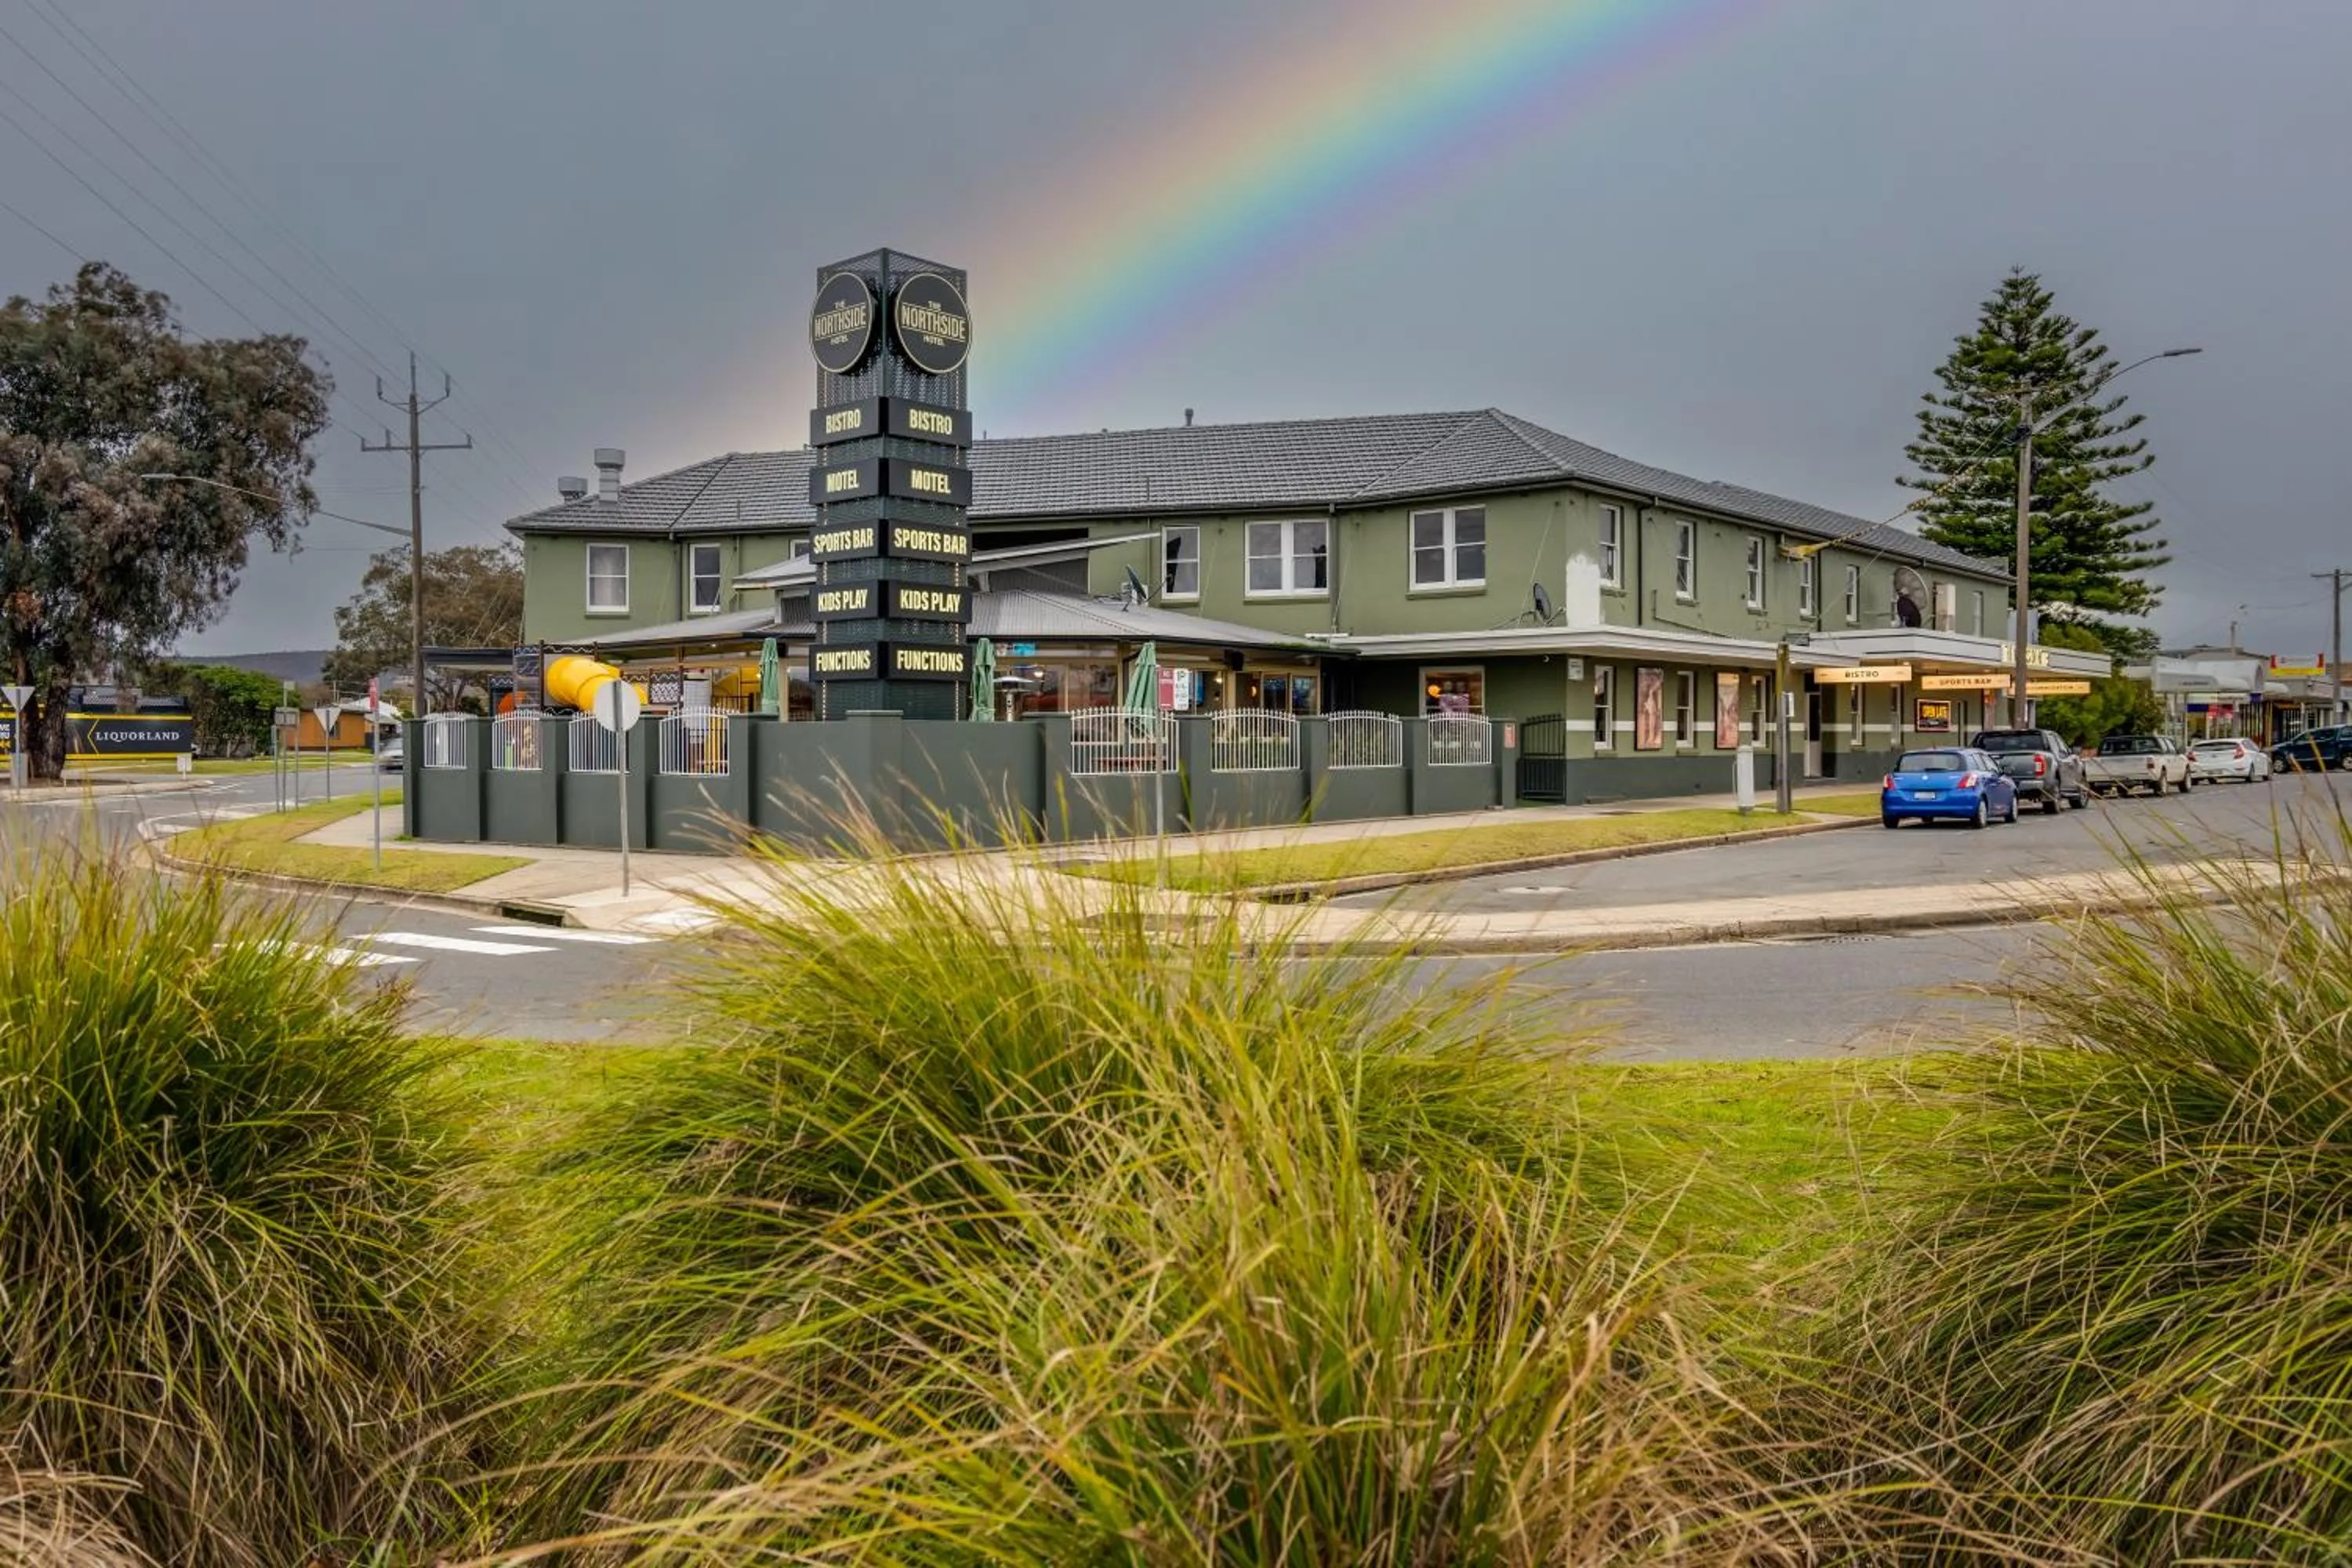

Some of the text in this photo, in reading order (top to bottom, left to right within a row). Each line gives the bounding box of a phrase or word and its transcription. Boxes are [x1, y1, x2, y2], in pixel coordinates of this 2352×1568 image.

[815, 305, 866, 338] NORTHSIDE
[902, 304, 966, 339] NORTHSIDE
[826, 408, 861, 434] BISTRO
[909, 408, 953, 435] BISTRO
[826, 469, 859, 493] MOTEL
[911, 469, 951, 494] MOTEL
[813, 528, 873, 554] SPORTS BAR
[894, 528, 967, 555] SPORTS BAR
[818, 589, 868, 612] KIDS PLAY
[900, 590, 961, 613] KIDS PLAY
[816, 650, 871, 672] FUNCTIONS
[896, 650, 964, 672] FUNCTIONS
[96, 731, 180, 742] LIQUORLAND
